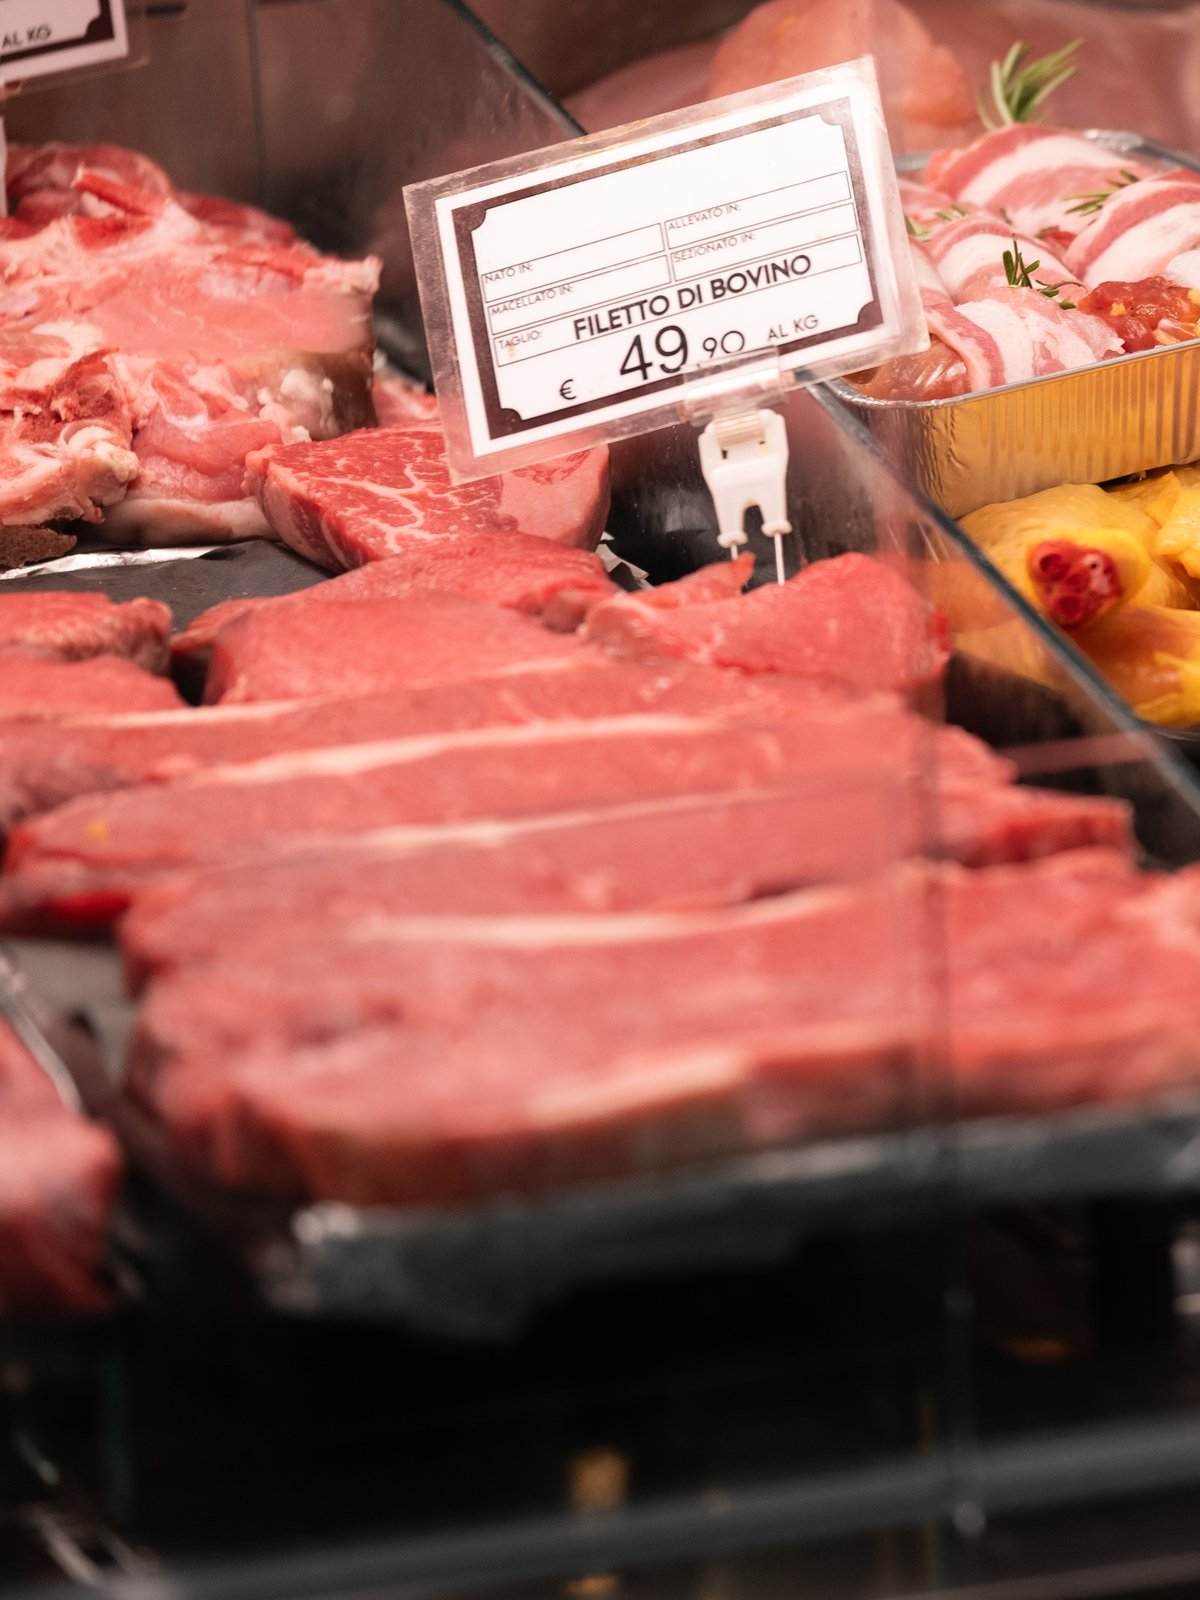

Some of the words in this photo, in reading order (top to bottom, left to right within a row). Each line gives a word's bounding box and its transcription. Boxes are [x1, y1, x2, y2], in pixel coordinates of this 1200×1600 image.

[668, 206, 723, 231] ALLEVATO
[674, 235, 738, 263] SEZIONATO
[484, 266, 516, 283] NATO
[491, 287, 556, 316] MACELLATO
[573, 295, 670, 340] FILETTO
[677, 284, 703, 309] DI
[710, 254, 811, 299] BOVINO
[498, 330, 542, 349] TAGLIO:
[559, 378, 576, 400] €
[619, 325, 689, 380] 49
[702, 330, 745, 358] 90
[767, 324, 788, 341] AL
[794, 315, 819, 333] KG
